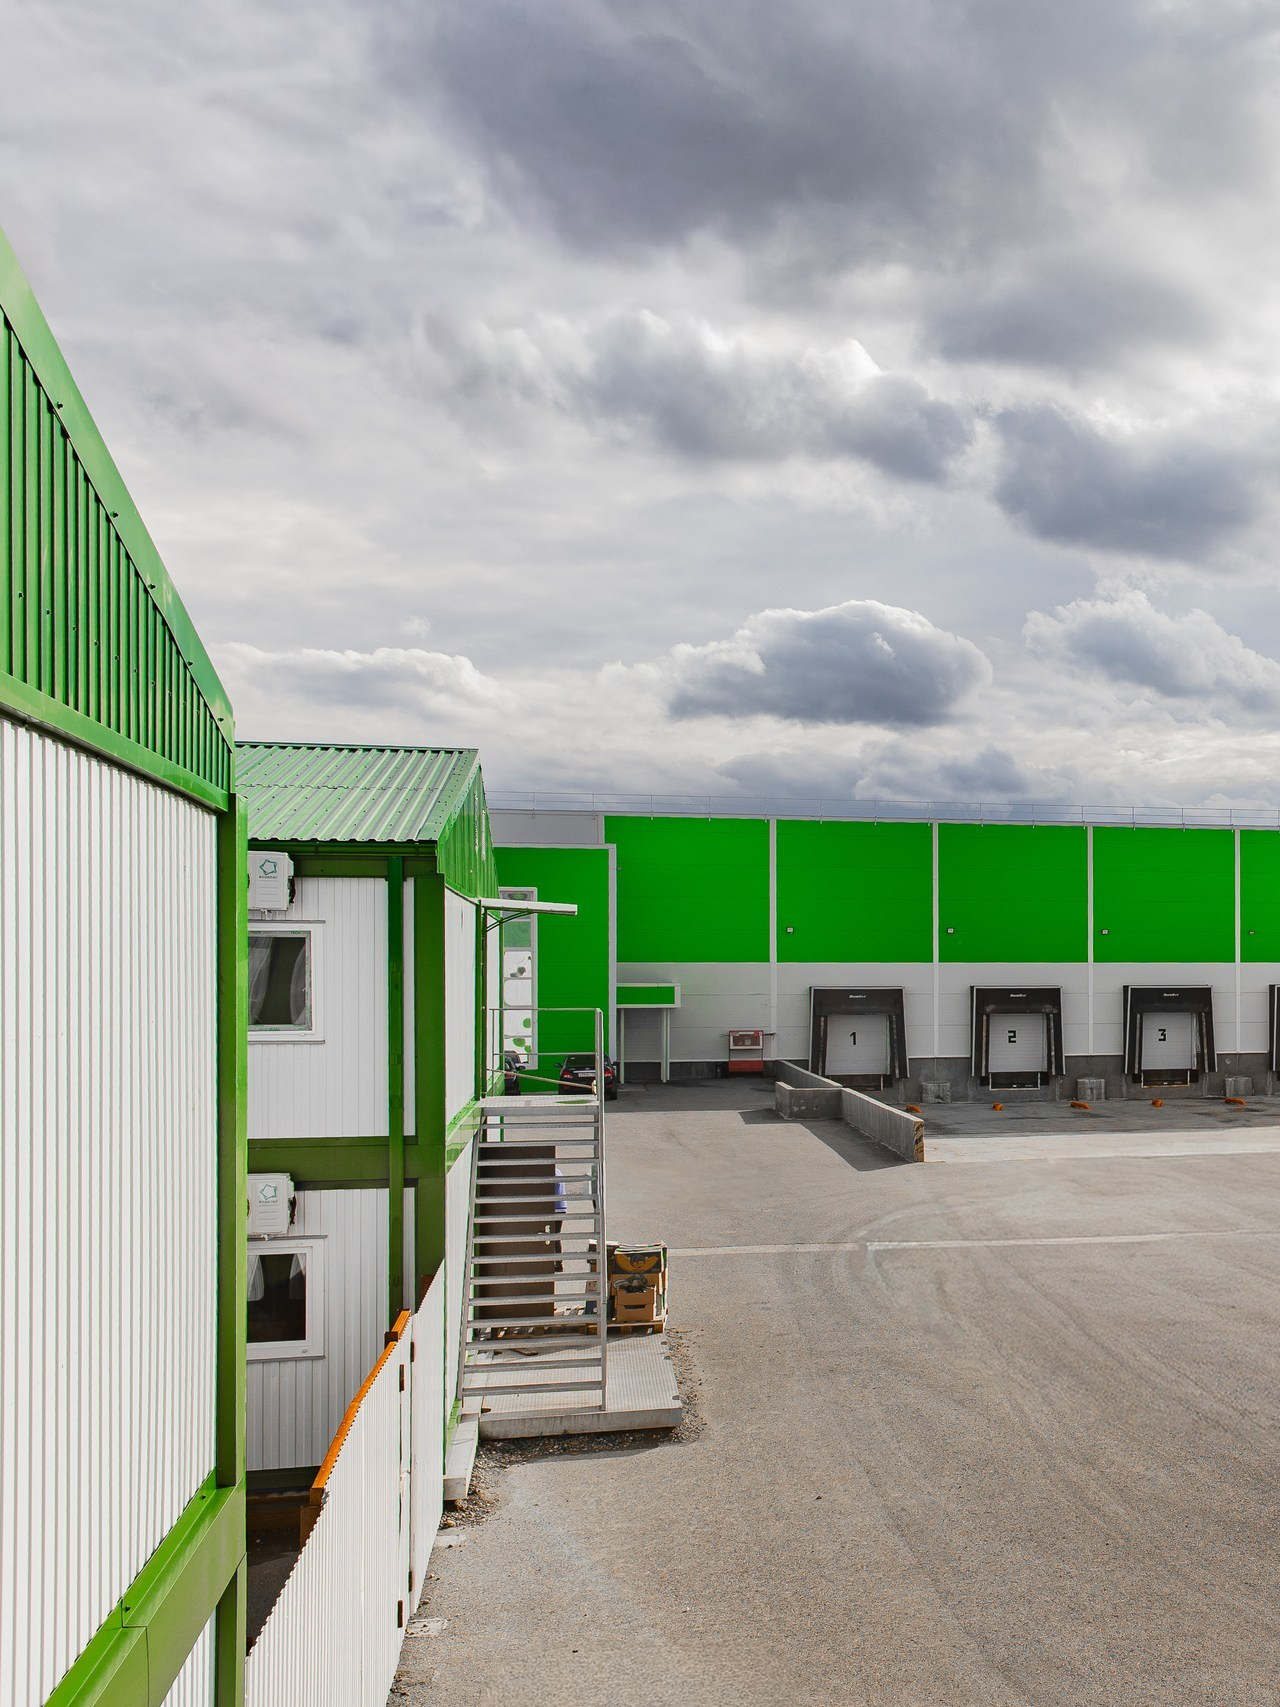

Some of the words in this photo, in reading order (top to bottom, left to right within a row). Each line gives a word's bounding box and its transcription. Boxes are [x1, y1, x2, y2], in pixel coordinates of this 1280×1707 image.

[850, 1031, 857, 1046] 1
[1008, 1030, 1017, 1043] 2
[1158, 1029, 1167, 1042] 3
